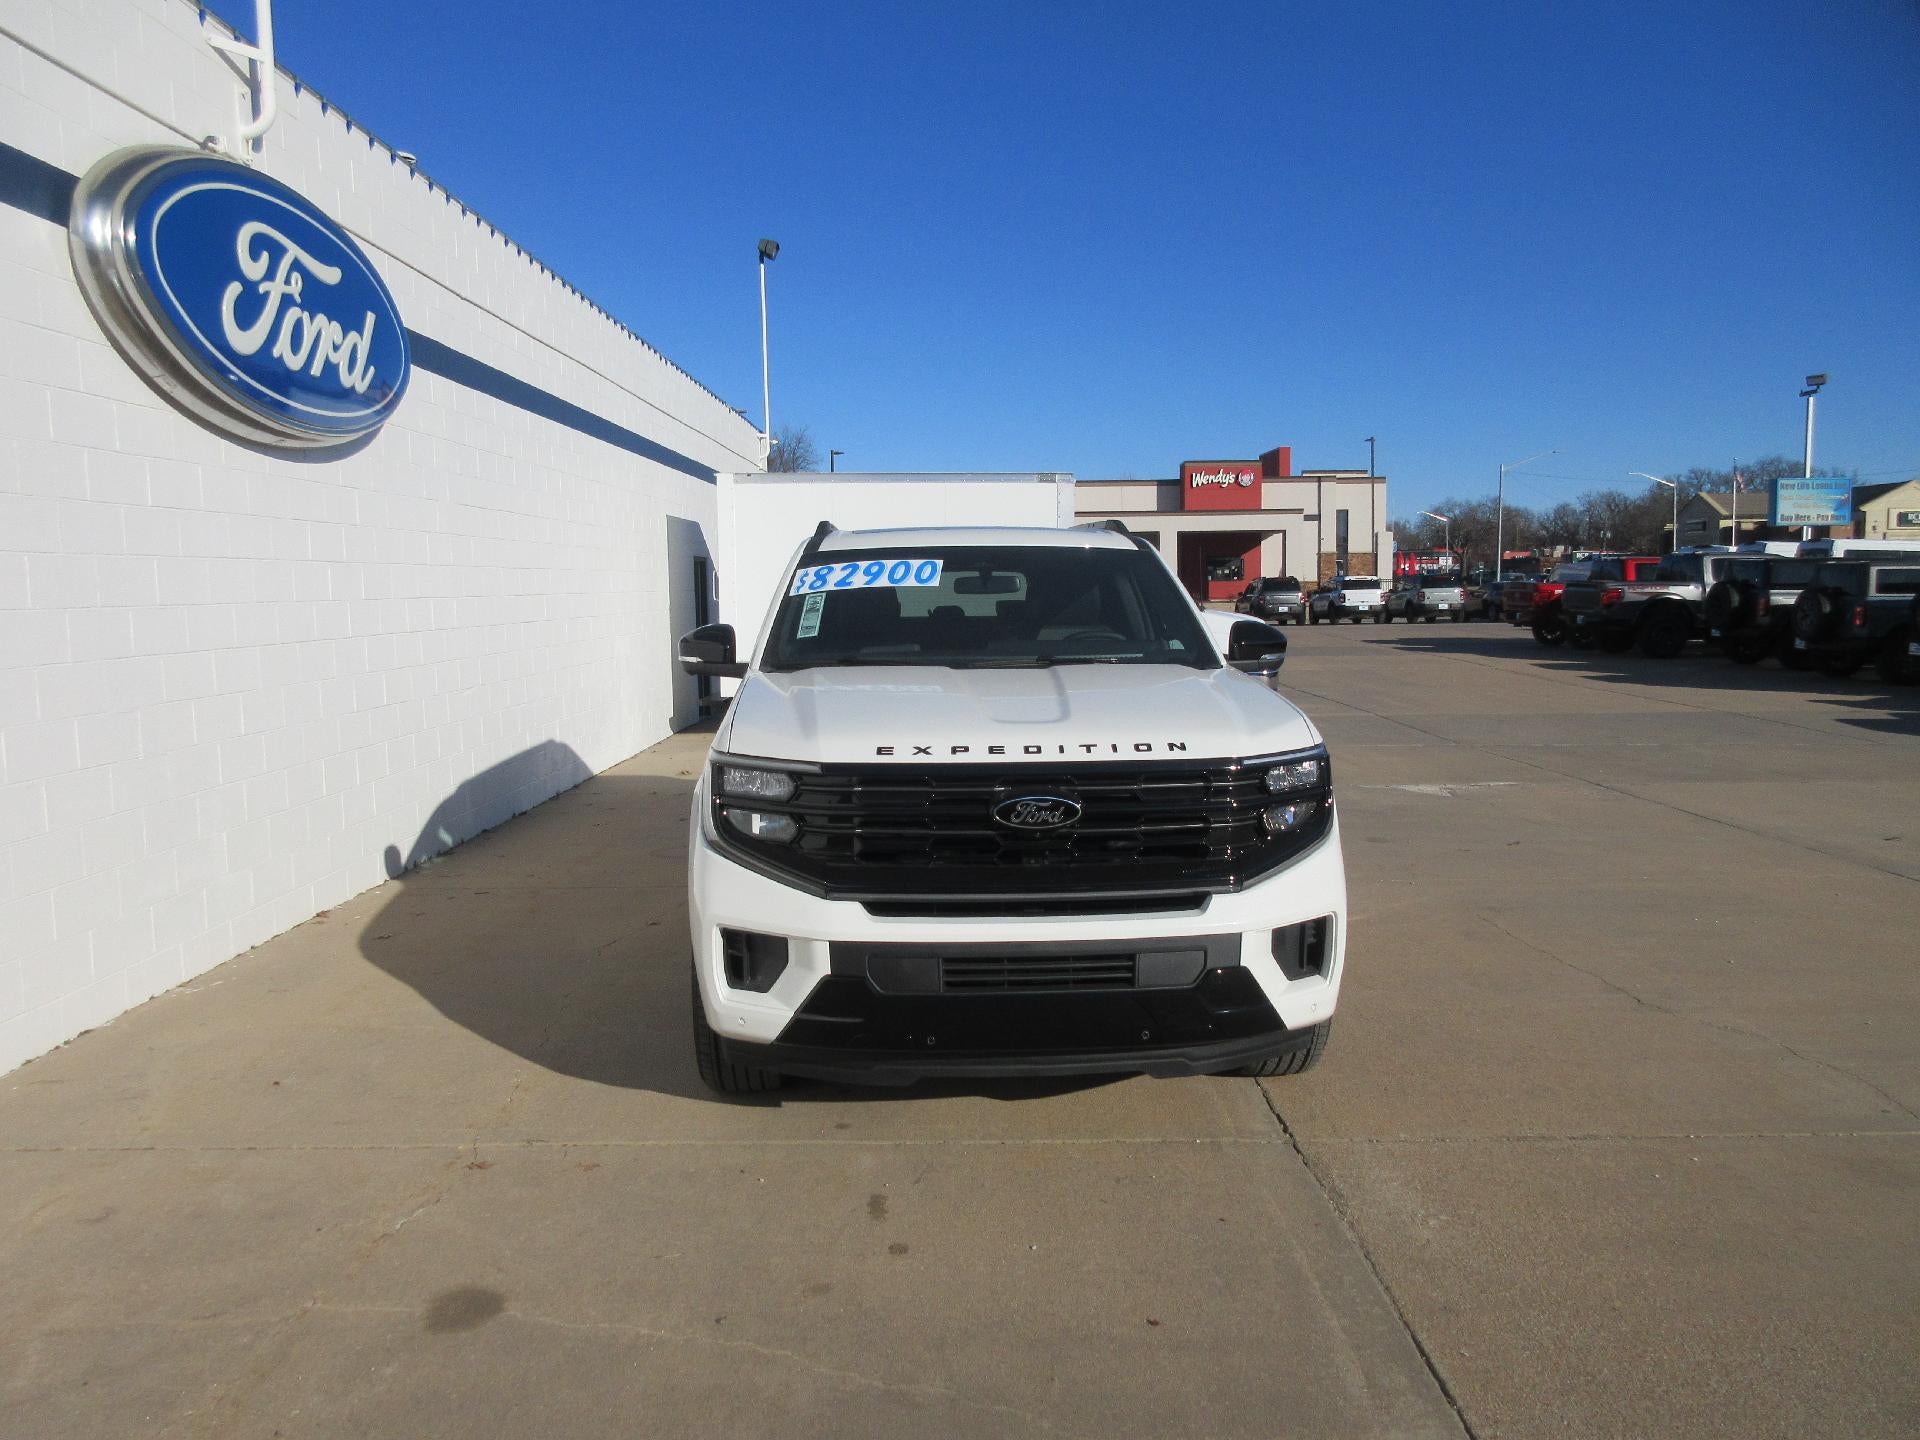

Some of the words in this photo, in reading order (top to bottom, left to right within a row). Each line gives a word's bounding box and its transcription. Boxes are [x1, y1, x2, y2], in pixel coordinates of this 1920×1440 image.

[222, 221, 376, 394] Ford
[1191, 468, 1236, 488] Wendy's
[1780, 514, 1794, 522] Buy
[795, 560, 939, 594] $82900
[876, 742, 1187, 756] EXPEDITION
[1011, 801, 1065, 824] Ford
